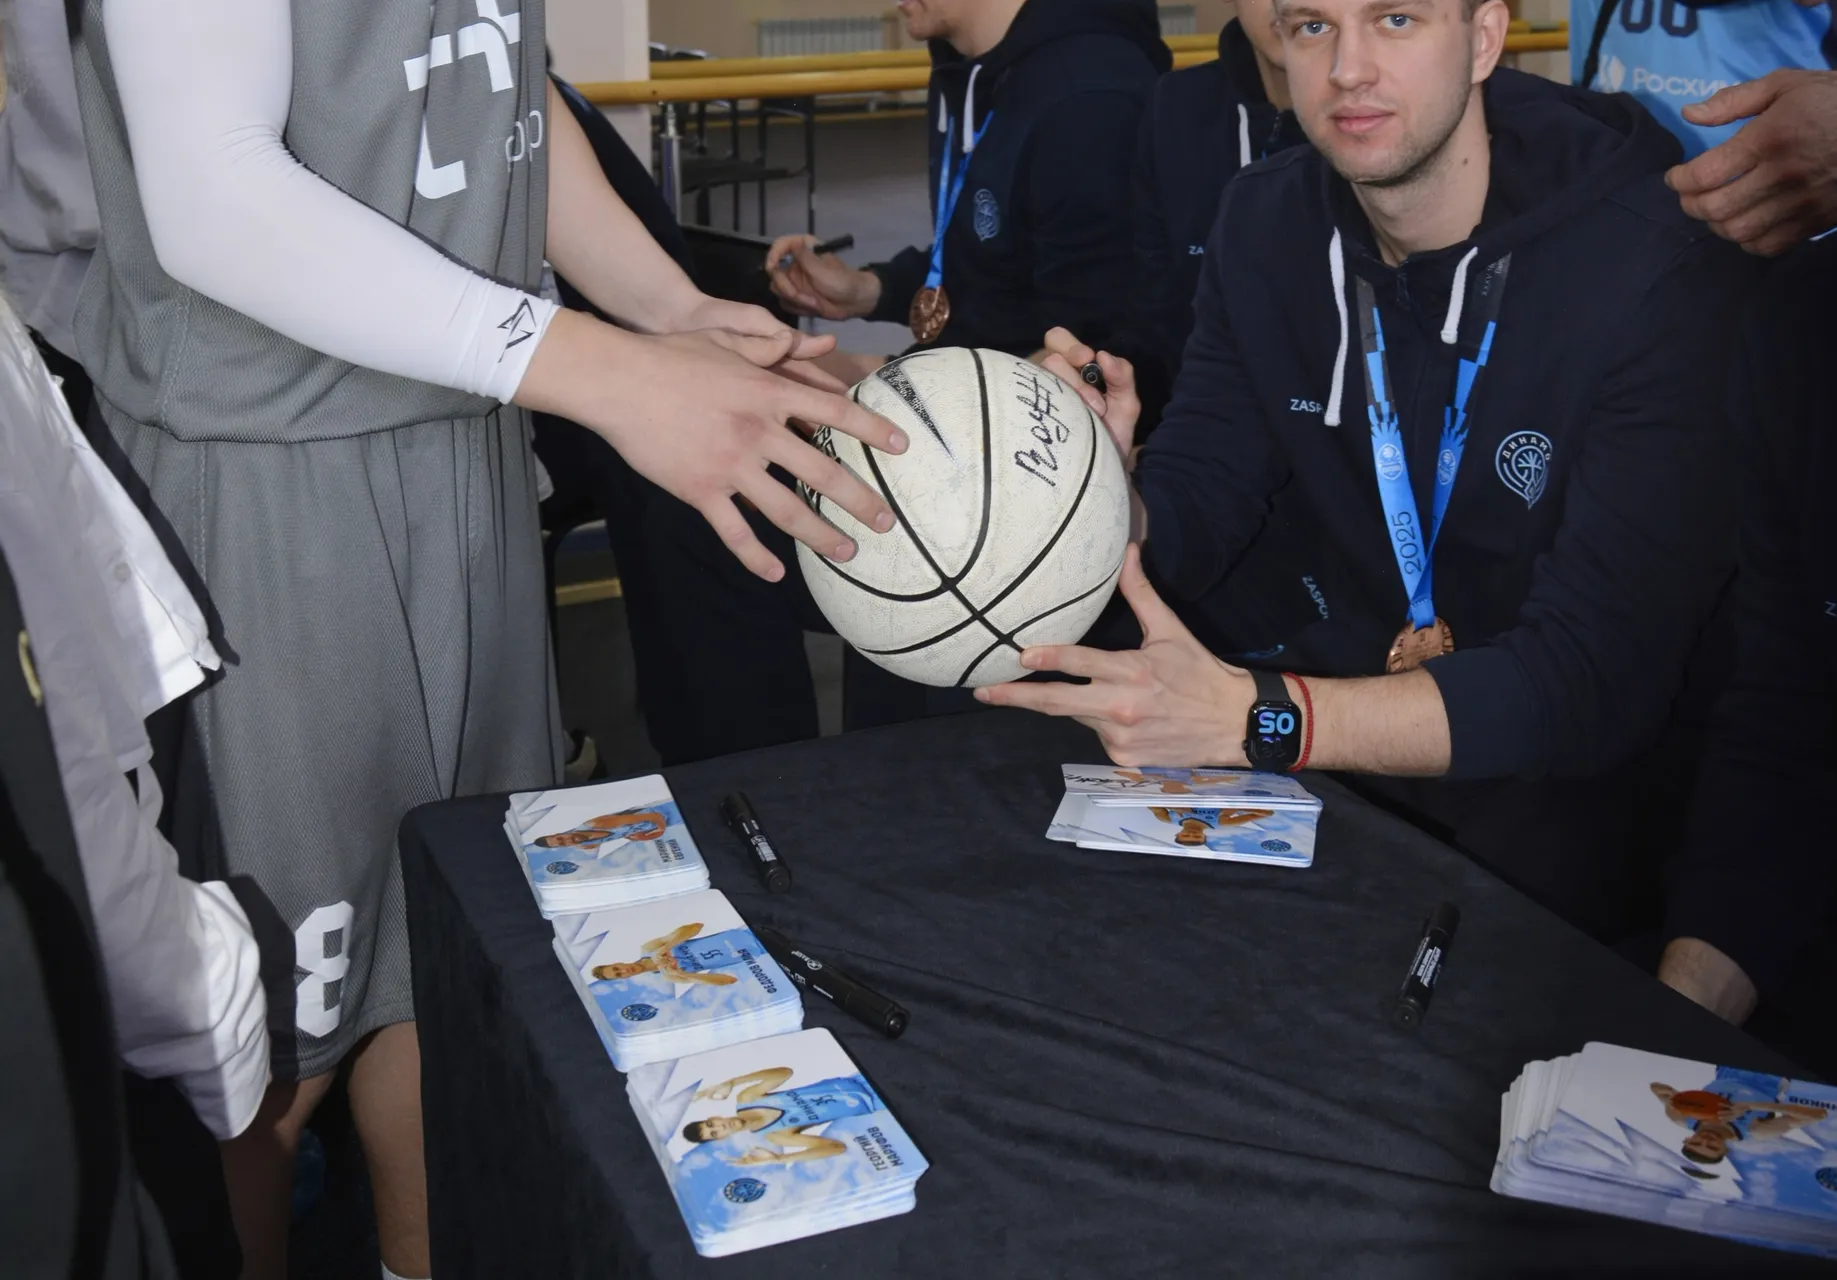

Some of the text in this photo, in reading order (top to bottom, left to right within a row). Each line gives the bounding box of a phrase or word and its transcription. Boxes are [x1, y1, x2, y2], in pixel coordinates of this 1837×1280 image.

[1502, 436, 1551, 461] ДИНАМО
[1391, 511, 1422, 575] 2025
[295, 900, 354, 1038] 8
[737, 947, 777, 994] ФЕДОРОВ ИЛЬЯ
[853, 1134, 888, 1171] ГЕОРГИЙ
[866, 1126, 905, 1167] МАРУФОВ
